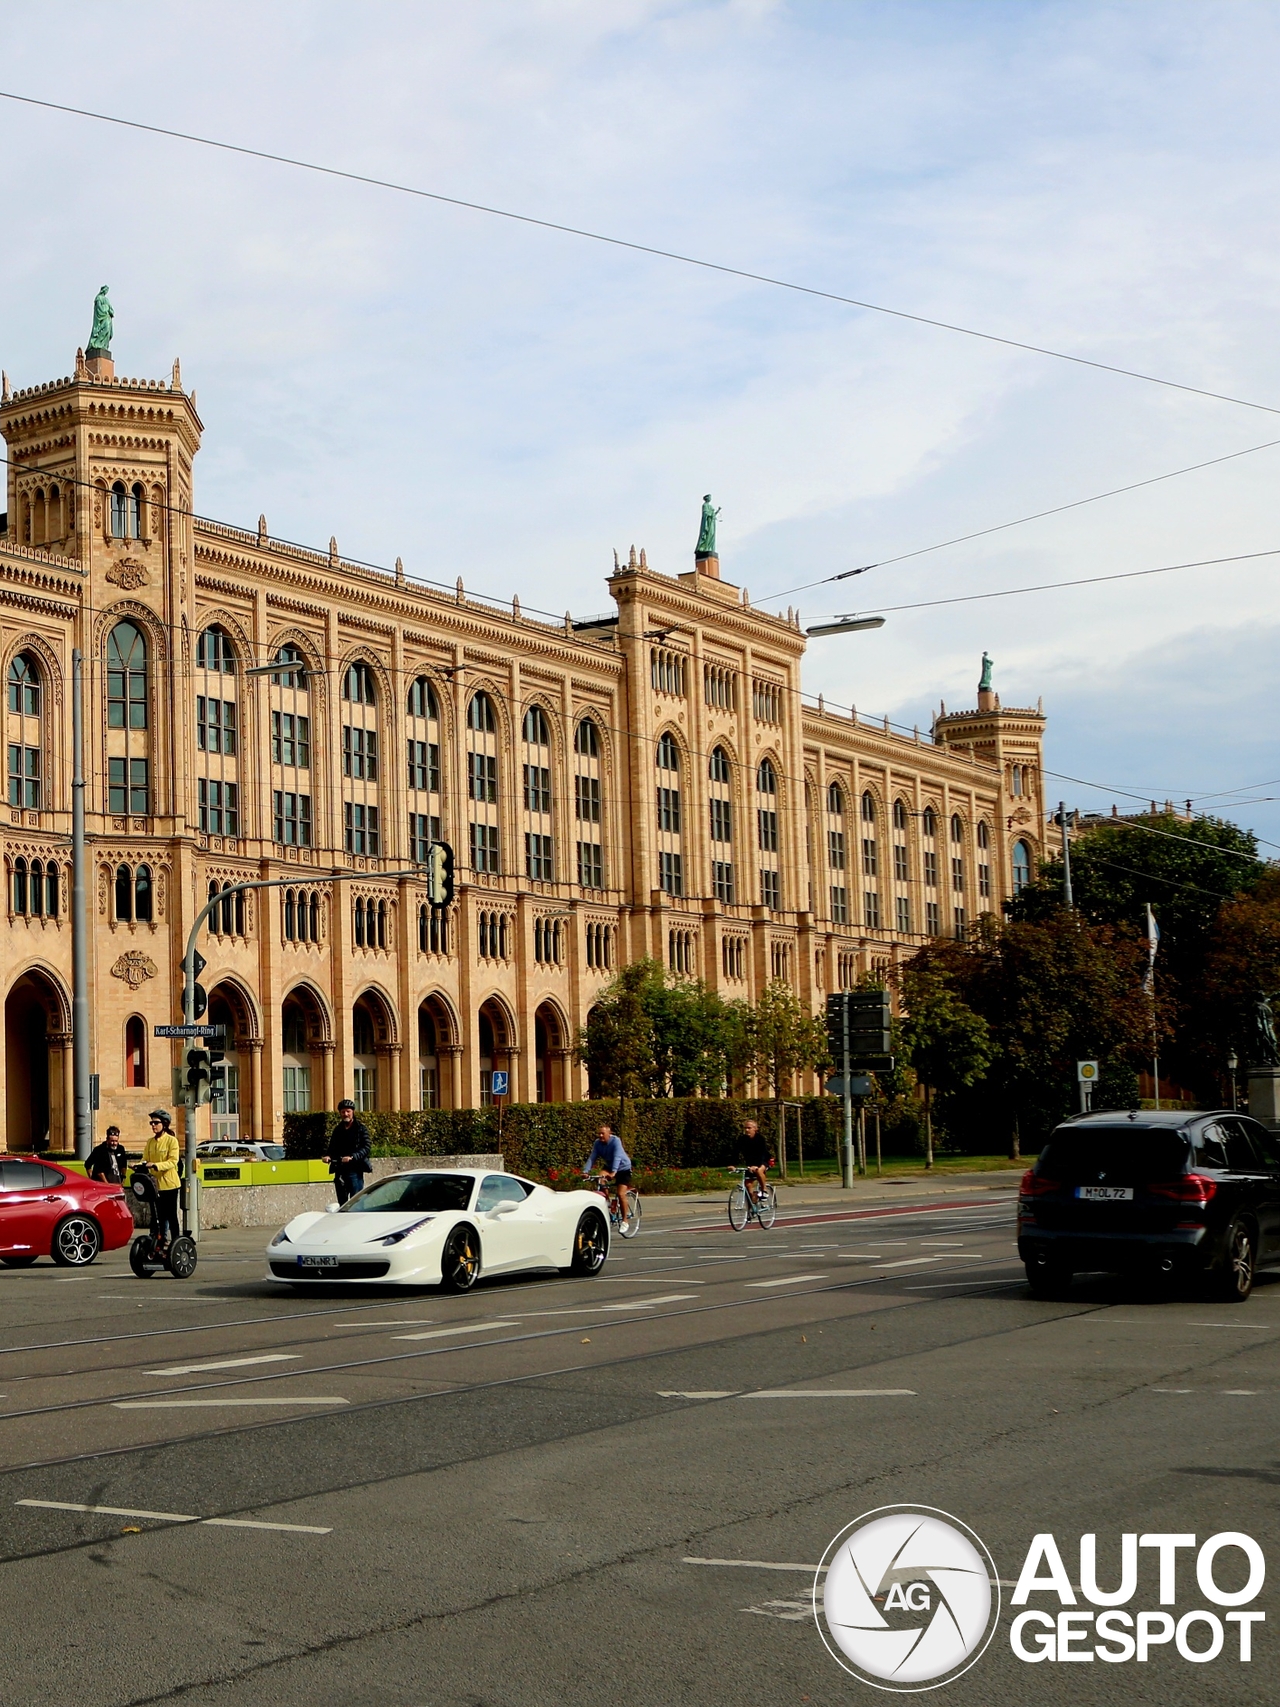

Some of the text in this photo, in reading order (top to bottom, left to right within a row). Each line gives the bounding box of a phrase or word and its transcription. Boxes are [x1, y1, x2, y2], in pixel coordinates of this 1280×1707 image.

[155, 1026, 214, 1036] Karl-Scharnagl-Ring
[1085, 1188, 1125, 1198] M OL 72
[332, 1257, 337, 1266] 1
